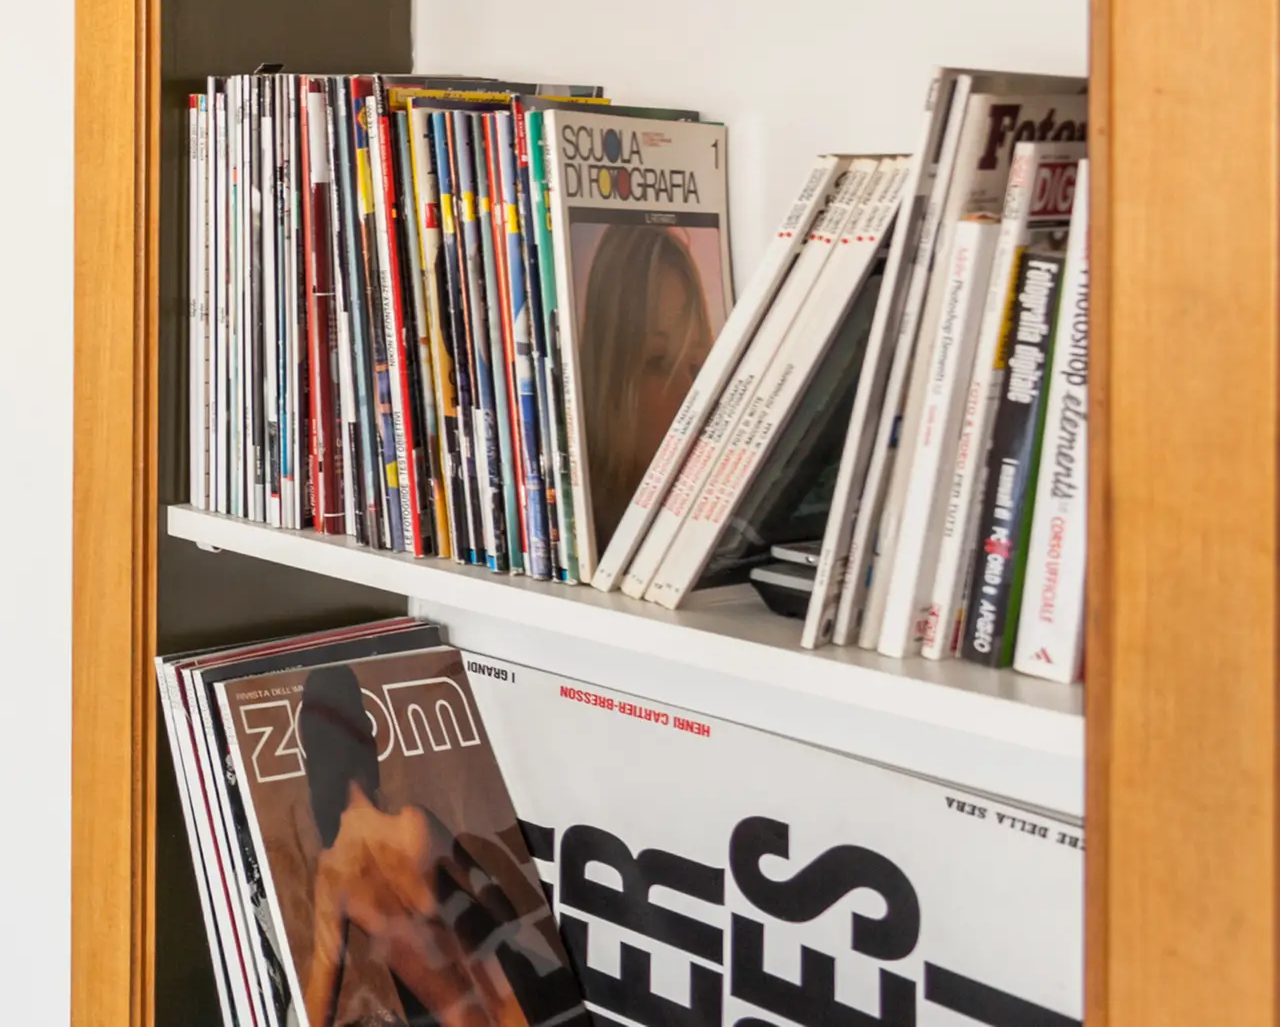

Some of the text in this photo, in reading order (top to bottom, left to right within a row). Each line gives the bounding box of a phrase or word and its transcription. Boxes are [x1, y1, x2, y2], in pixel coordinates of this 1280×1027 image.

[562, 124, 644, 166] SCUOLA
[710, 138, 720, 170] 1
[565, 163, 700, 204] DI FOTOGRAFIA
[942, 279, 964, 334] Photoshop
[1018, 260, 1059, 343] Fotografia
[388, 340, 396, 367] NIKON
[936, 335, 954, 383] Elements
[1007, 344, 1045, 404] digitale
[1051, 391, 1088, 499] elements
[395, 411, 412, 546] LE FOTOGUIDE TEST OBIETTIVI
[1039, 516, 1066, 624] CORSO UFFICIALE
[467, 660, 516, 683] I GRANDI
[559, 684, 711, 737] HENRI CARTIER-BRESSON
[944, 794, 1048, 841] DELLA SERA
